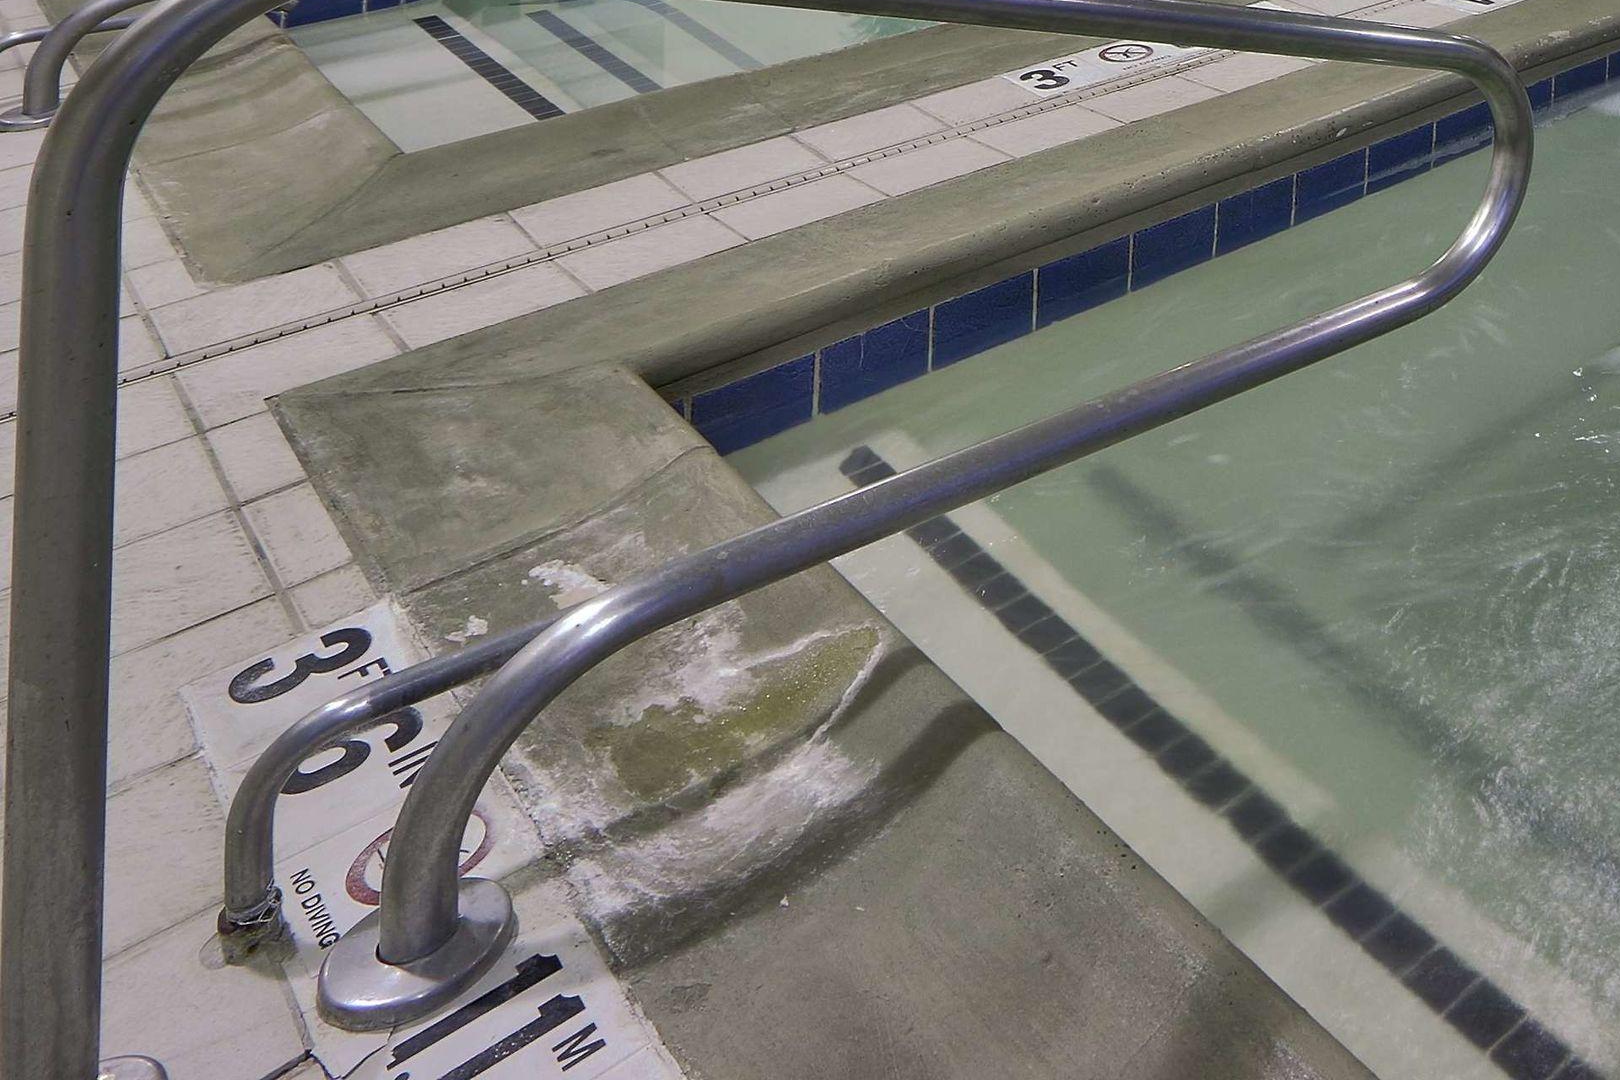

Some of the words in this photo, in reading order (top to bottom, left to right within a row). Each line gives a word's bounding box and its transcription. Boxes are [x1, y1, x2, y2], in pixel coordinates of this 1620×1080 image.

[1019, 69, 1070, 90] 3
[1053, 59, 1078, 72] FT
[228, 627, 372, 703] 3
[336, 656, 398, 680] F
[280, 706, 424, 794] 6
[290, 868, 315, 895] NO
[301, 893, 341, 950] DIVING
[551, 1022, 606, 1072] M
